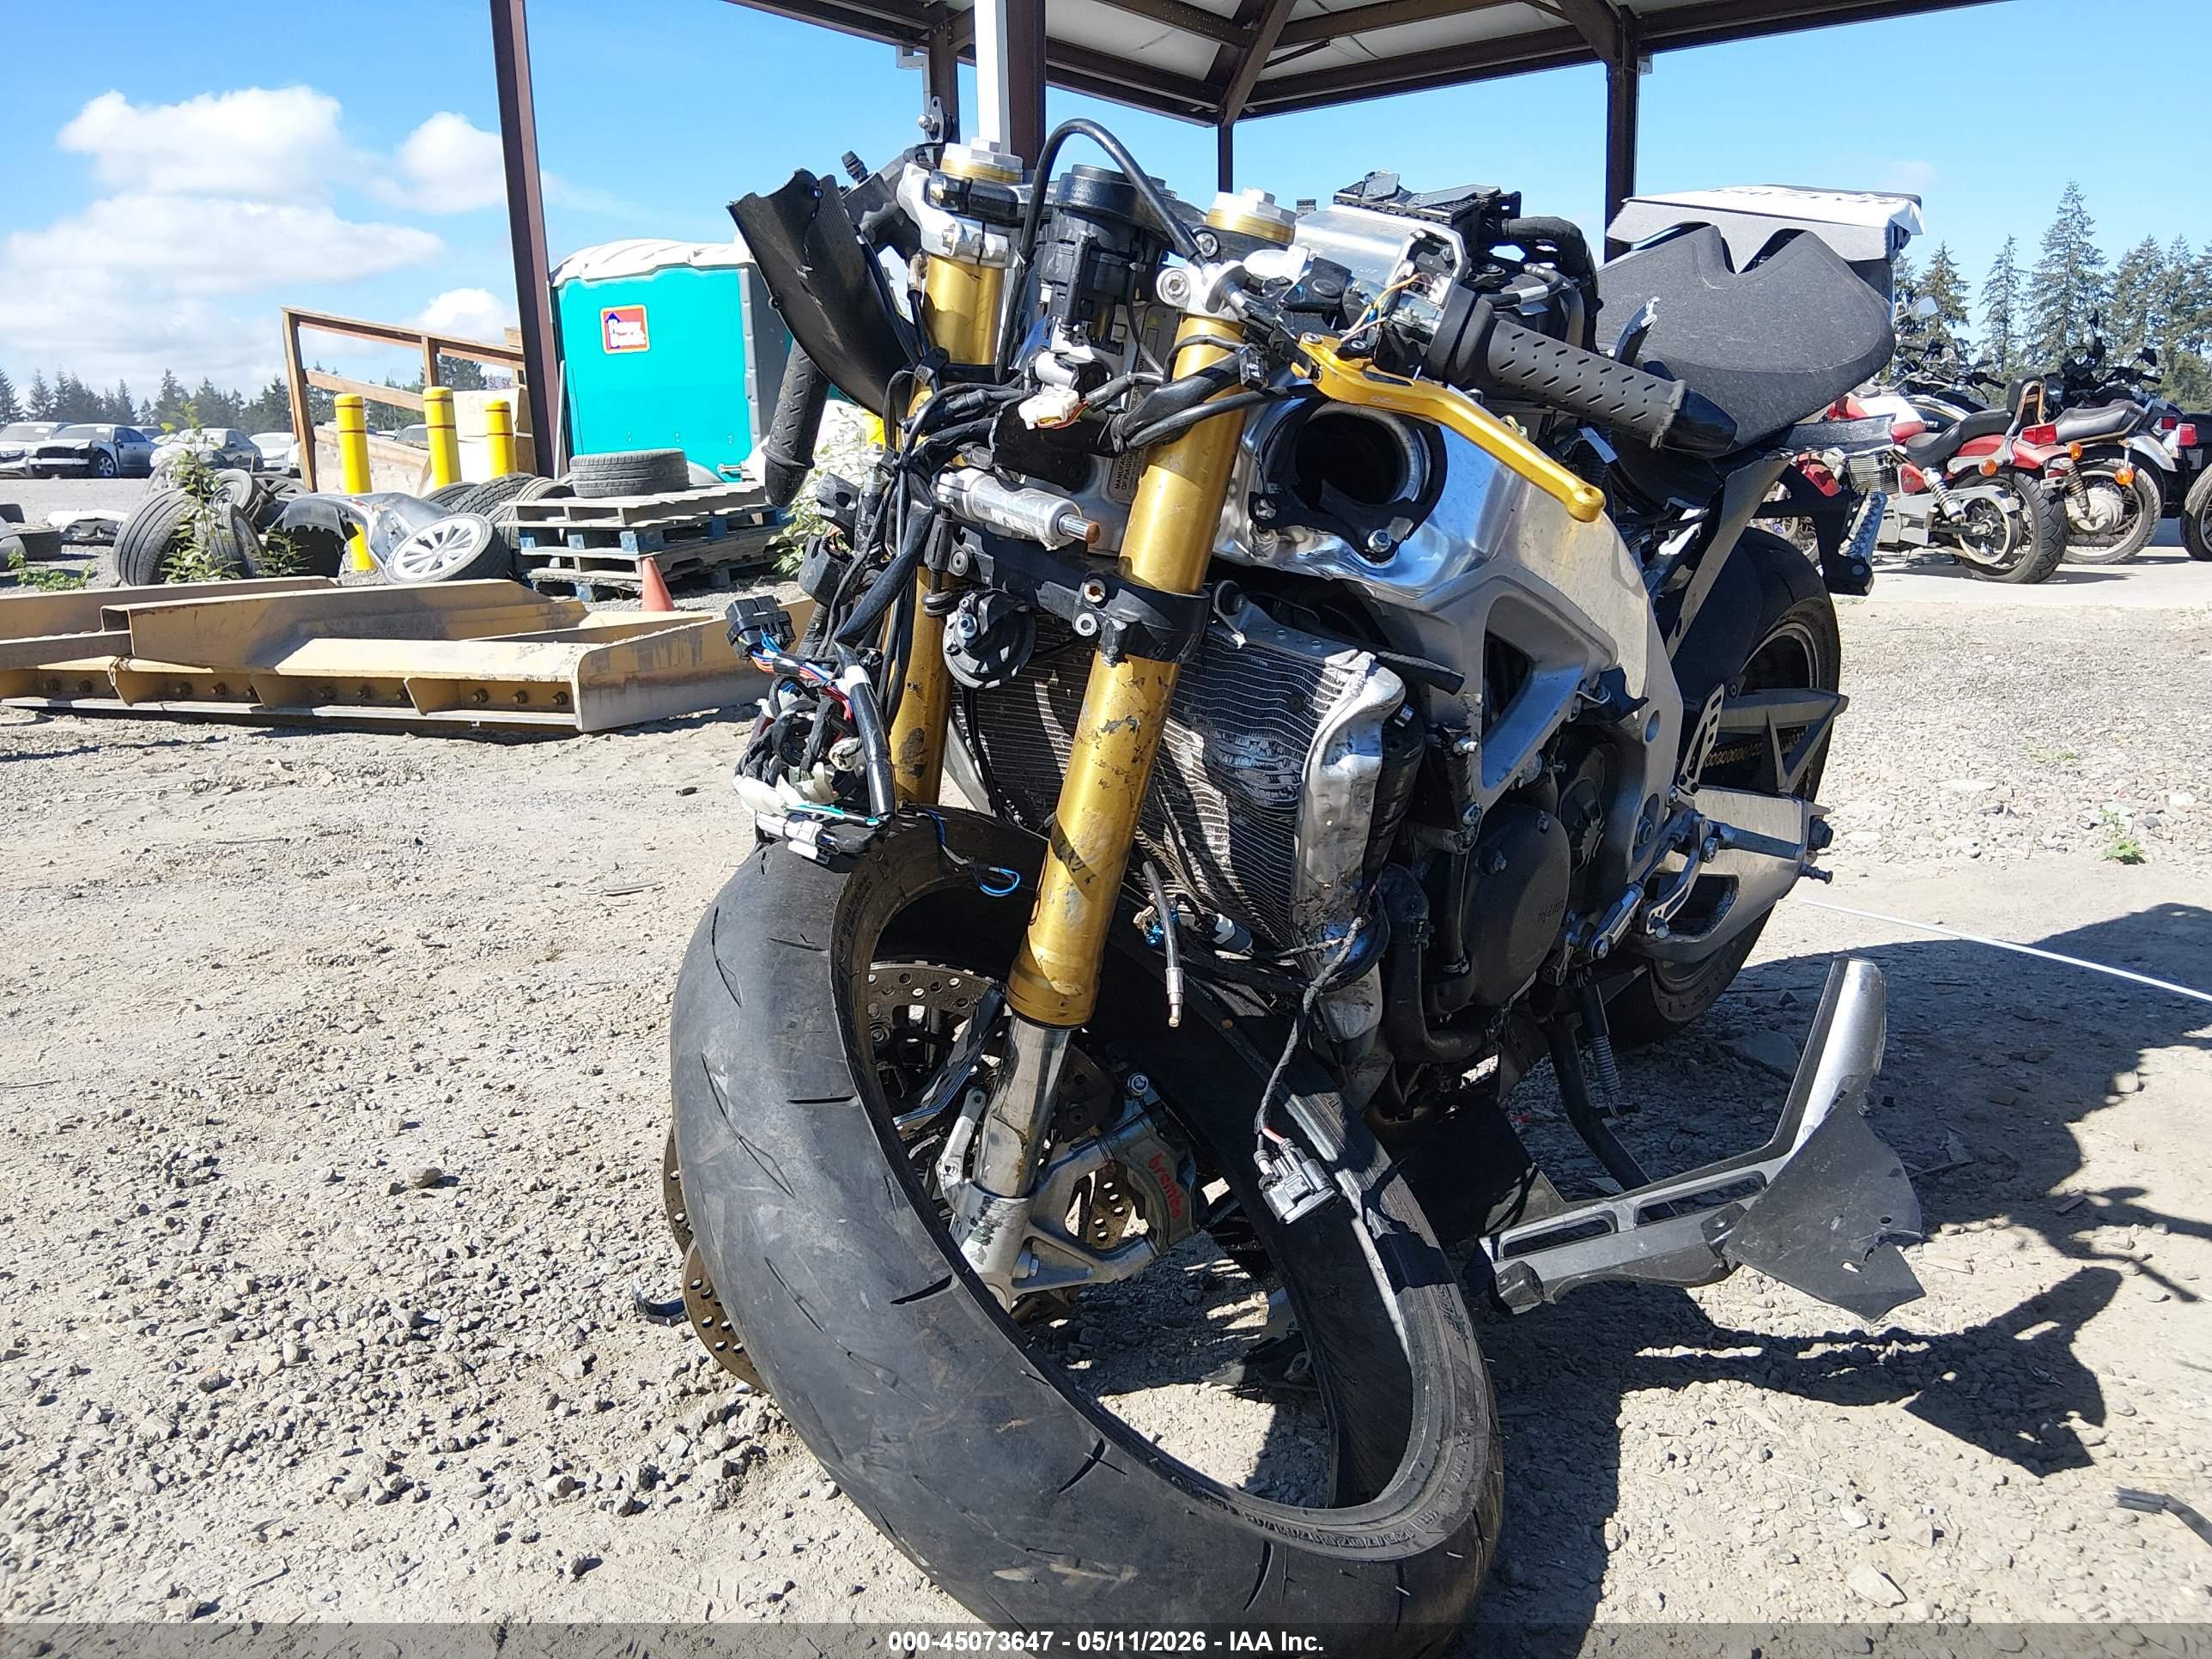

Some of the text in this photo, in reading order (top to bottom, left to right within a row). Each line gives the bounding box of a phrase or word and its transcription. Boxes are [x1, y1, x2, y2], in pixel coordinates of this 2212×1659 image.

[1115, 453, 1127, 490] MANUFAC
[1122, 453, 1133, 479] PIAGGI
[1147, 1152, 1182, 1219] brembo
